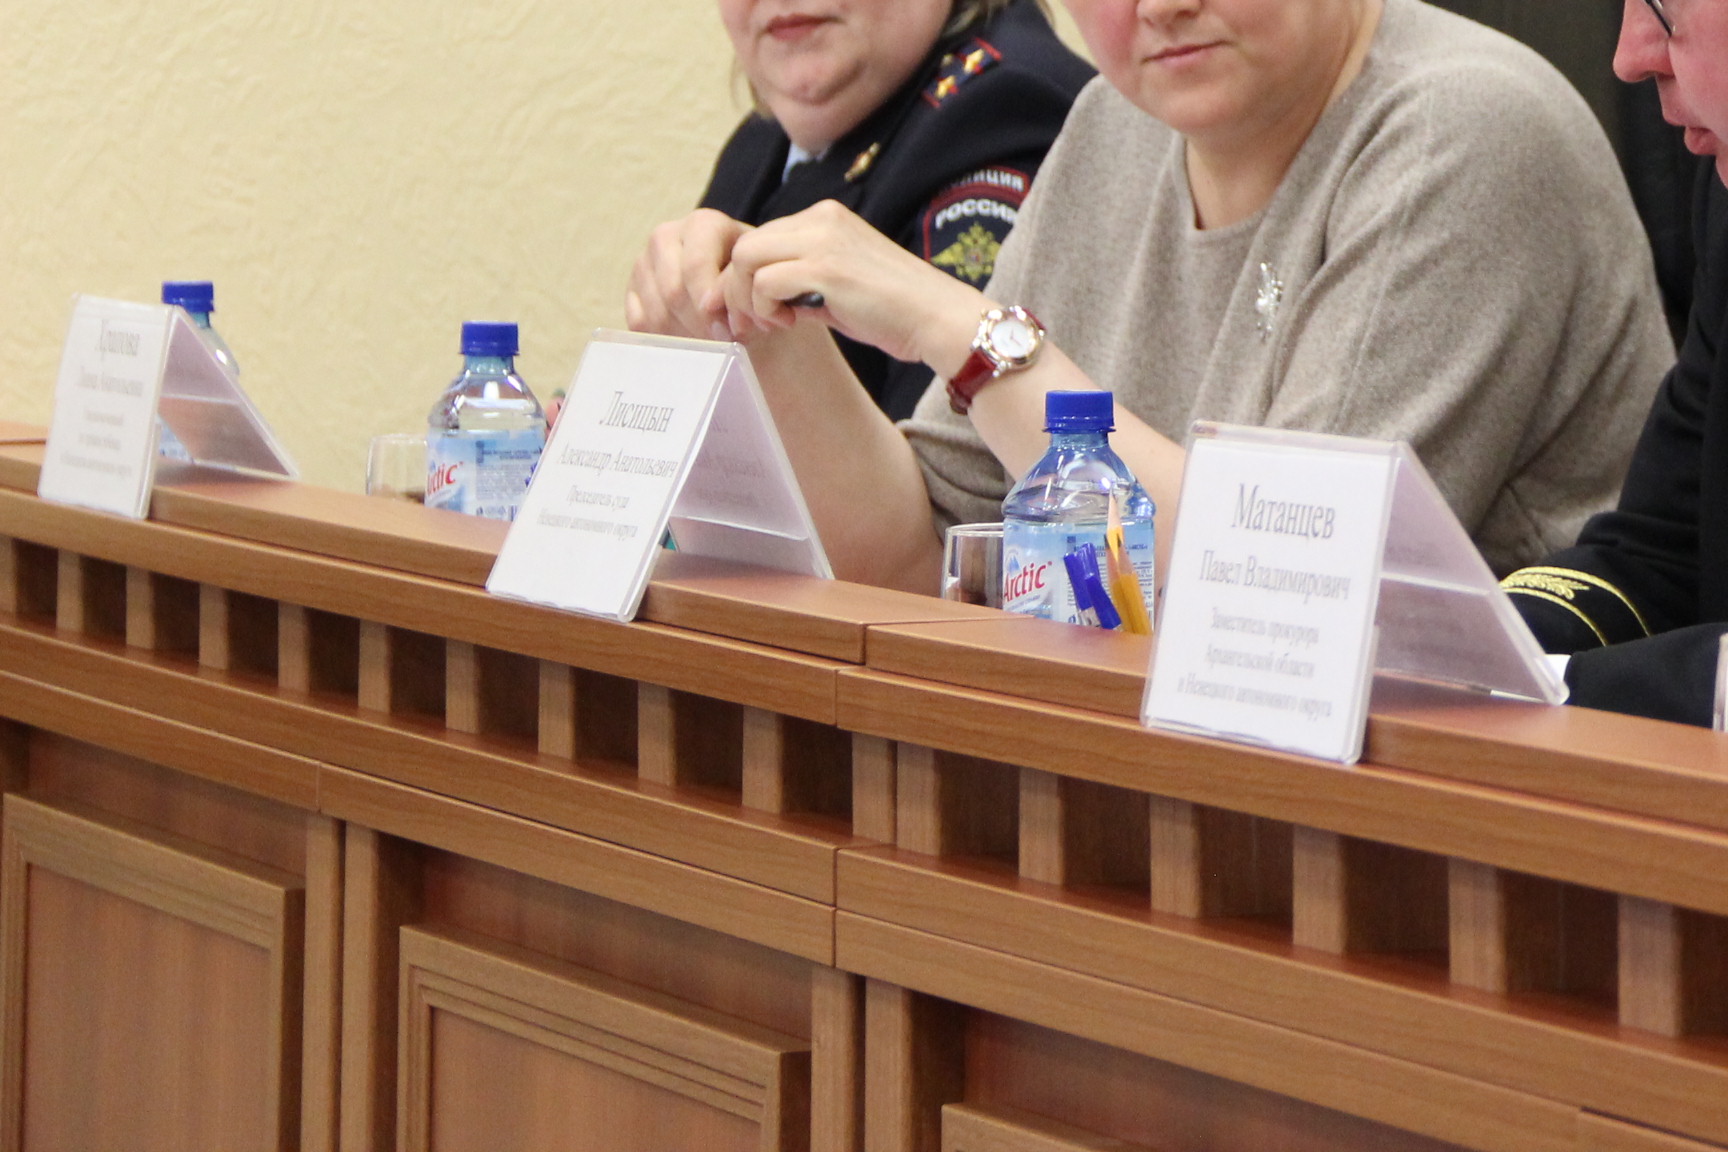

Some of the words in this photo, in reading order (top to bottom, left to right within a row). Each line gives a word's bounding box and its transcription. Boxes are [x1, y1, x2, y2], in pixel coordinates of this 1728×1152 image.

[599, 390, 675, 433] Лисицын
[557, 442, 613, 478] Александр
[609, 448, 679, 478] Анатольевич
[1231, 483, 1336, 539] Матанцев
[1004, 562, 1047, 602] Arctic
[1199, 550, 1243, 584] Павел
[1243, 555, 1351, 604] Владимирович
